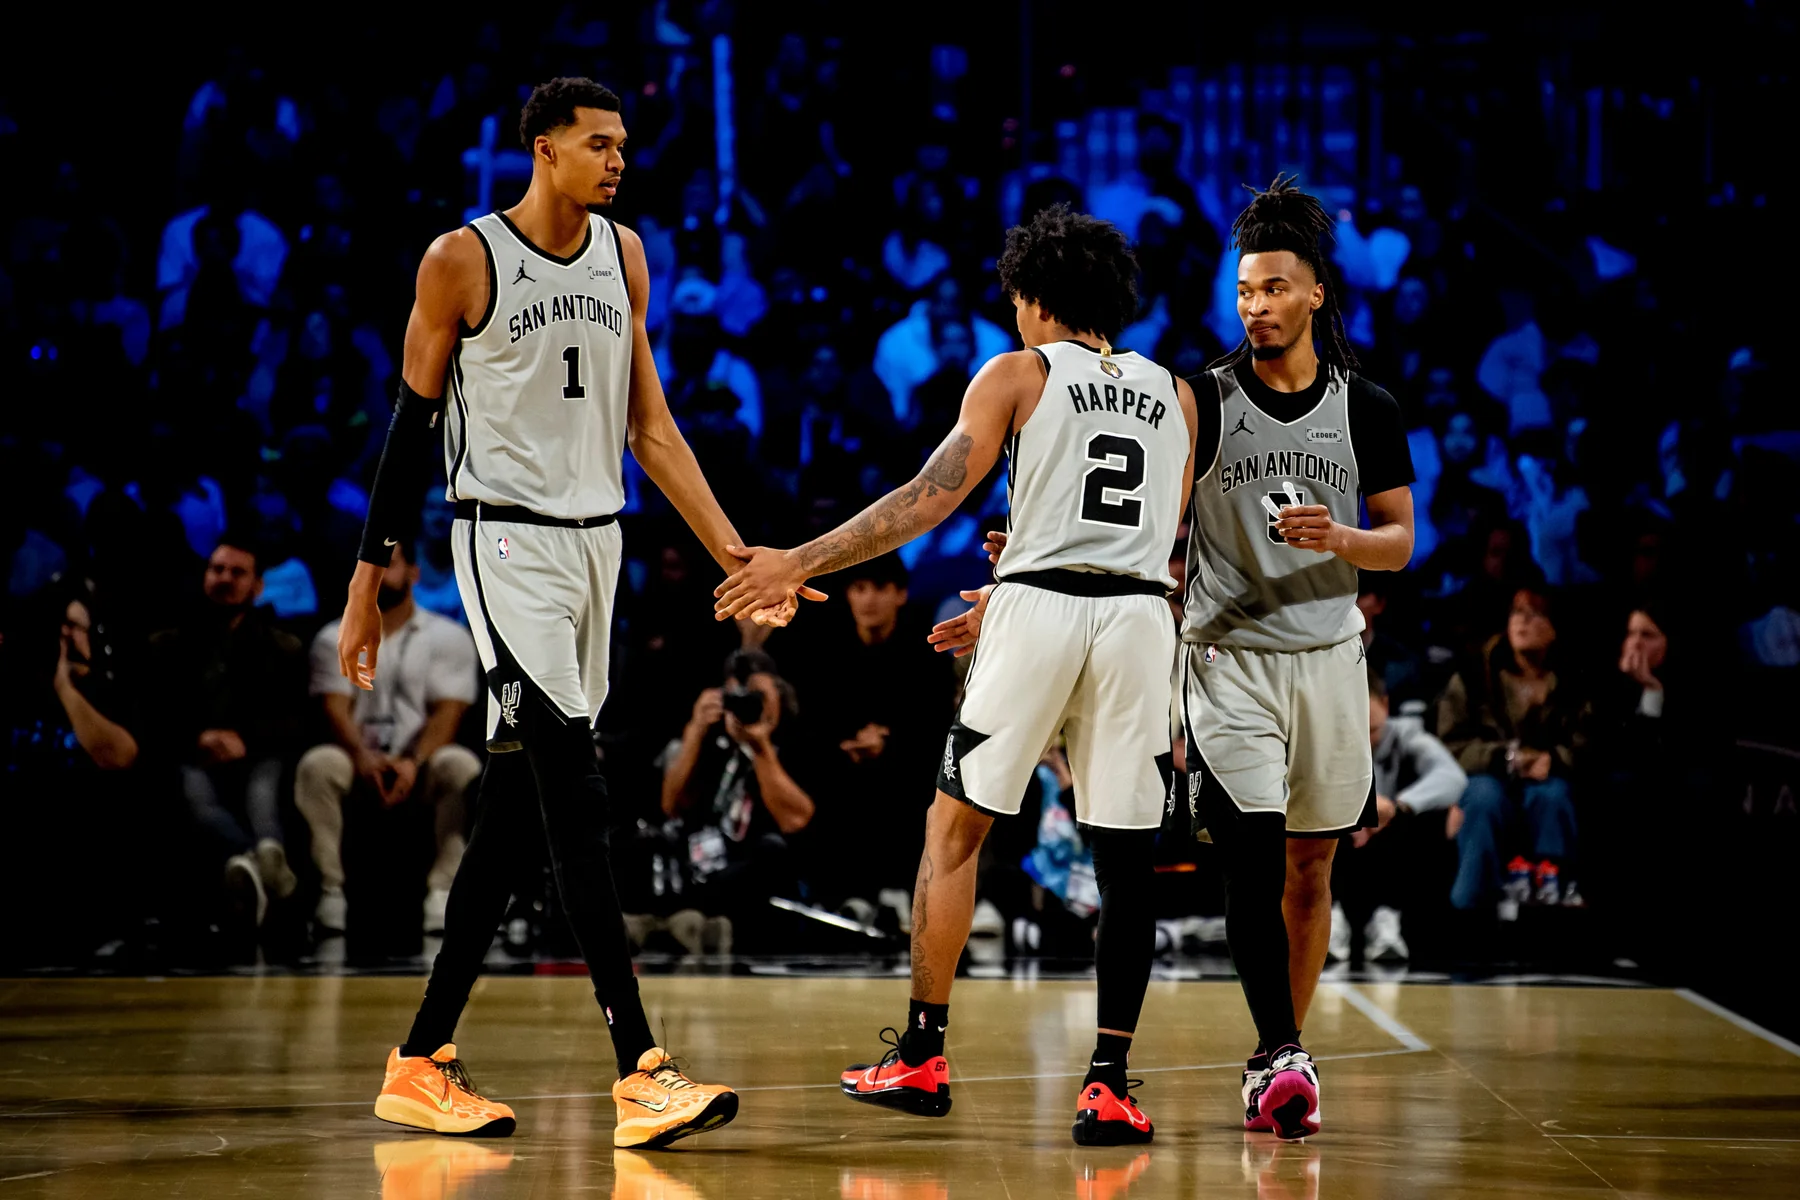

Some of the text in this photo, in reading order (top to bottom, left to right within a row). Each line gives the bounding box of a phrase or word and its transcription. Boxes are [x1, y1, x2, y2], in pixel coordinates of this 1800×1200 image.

[508, 294, 622, 345] SAN ANTONIO
[562, 345, 586, 400] 1
[1067, 382, 1166, 430] HARPER
[1078, 430, 1148, 530] 2
[1220, 450, 1349, 497] SAN ANTONIO
